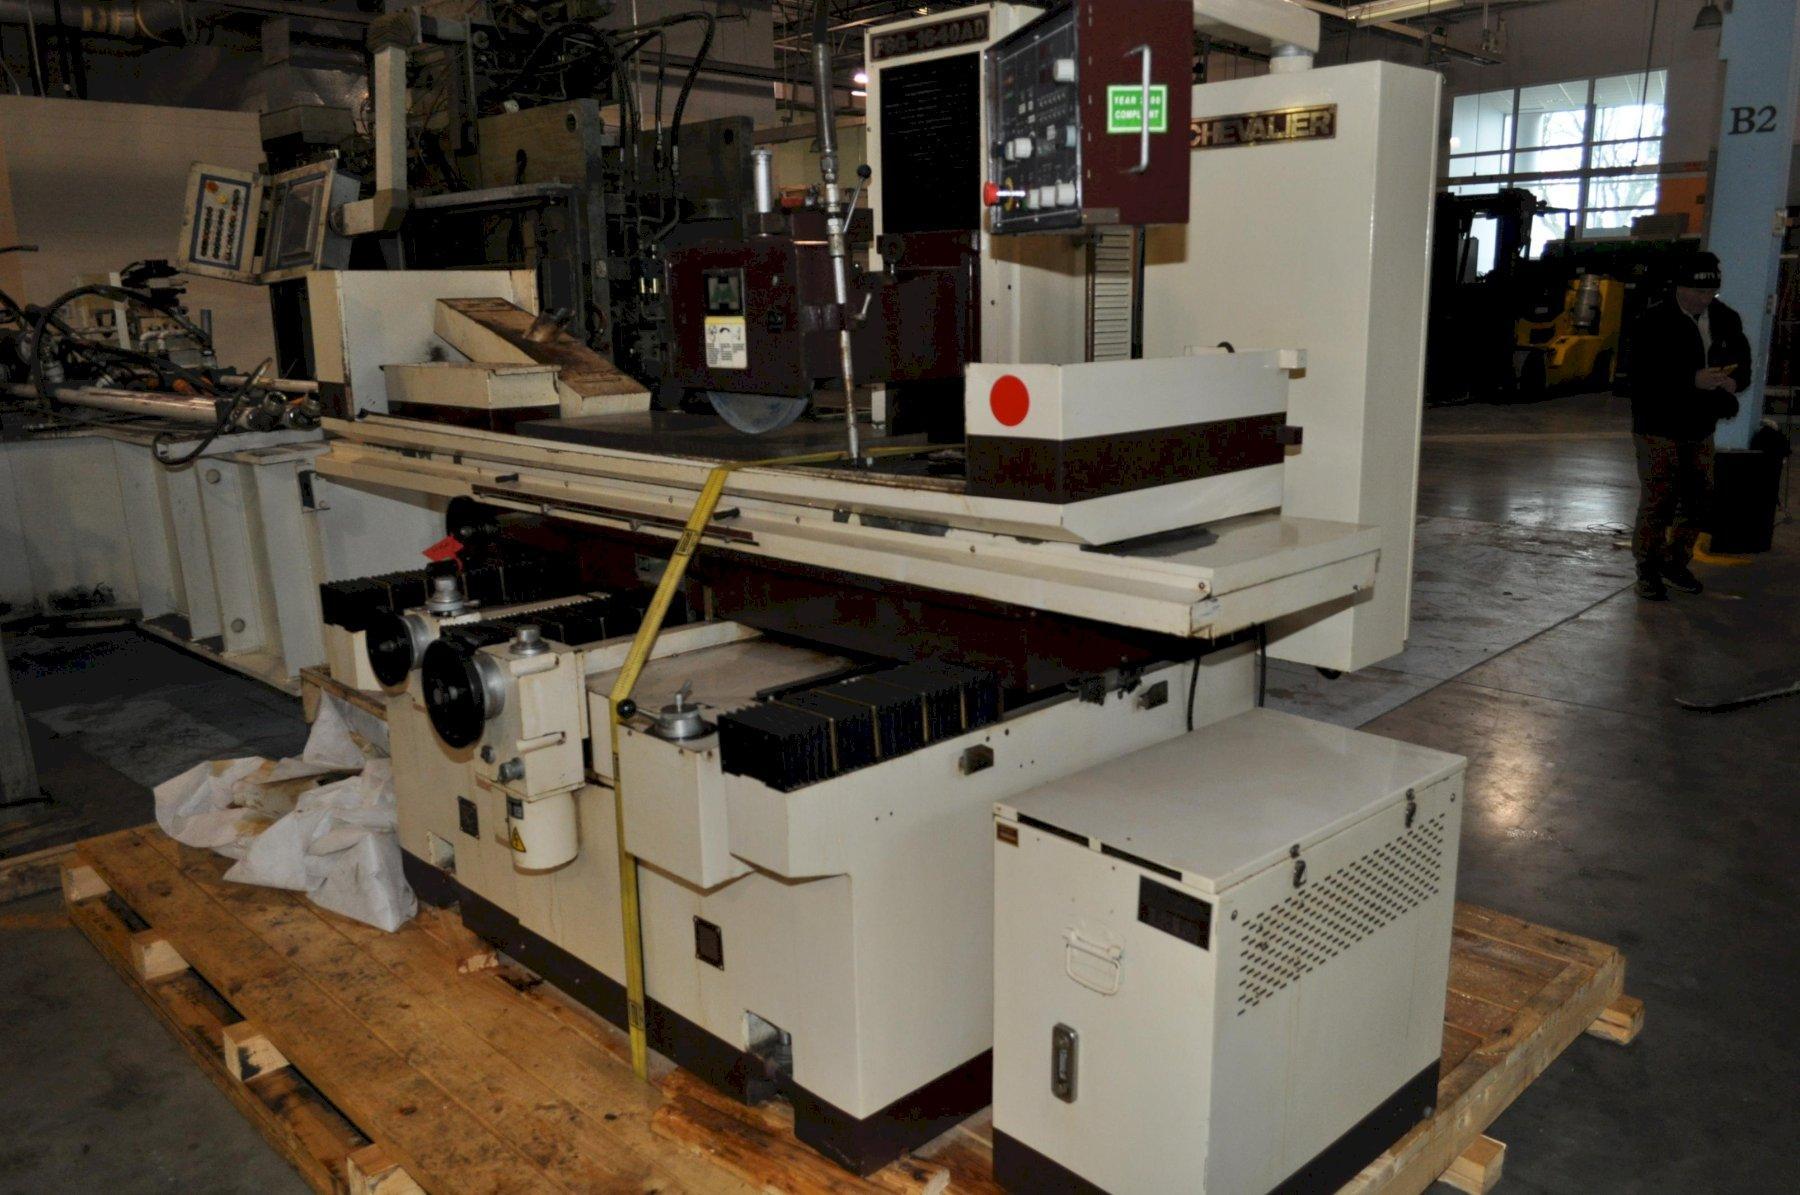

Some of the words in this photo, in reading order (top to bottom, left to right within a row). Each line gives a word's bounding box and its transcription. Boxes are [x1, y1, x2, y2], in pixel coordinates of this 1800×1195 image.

[1114, 96, 1137, 105] YEAR
[1140, 96, 1161, 105] 00
[1114, 110, 1159, 119] COMPLNT
[1728, 105, 1777, 136] B2
[1190, 110, 1332, 147] CHEVALIER
